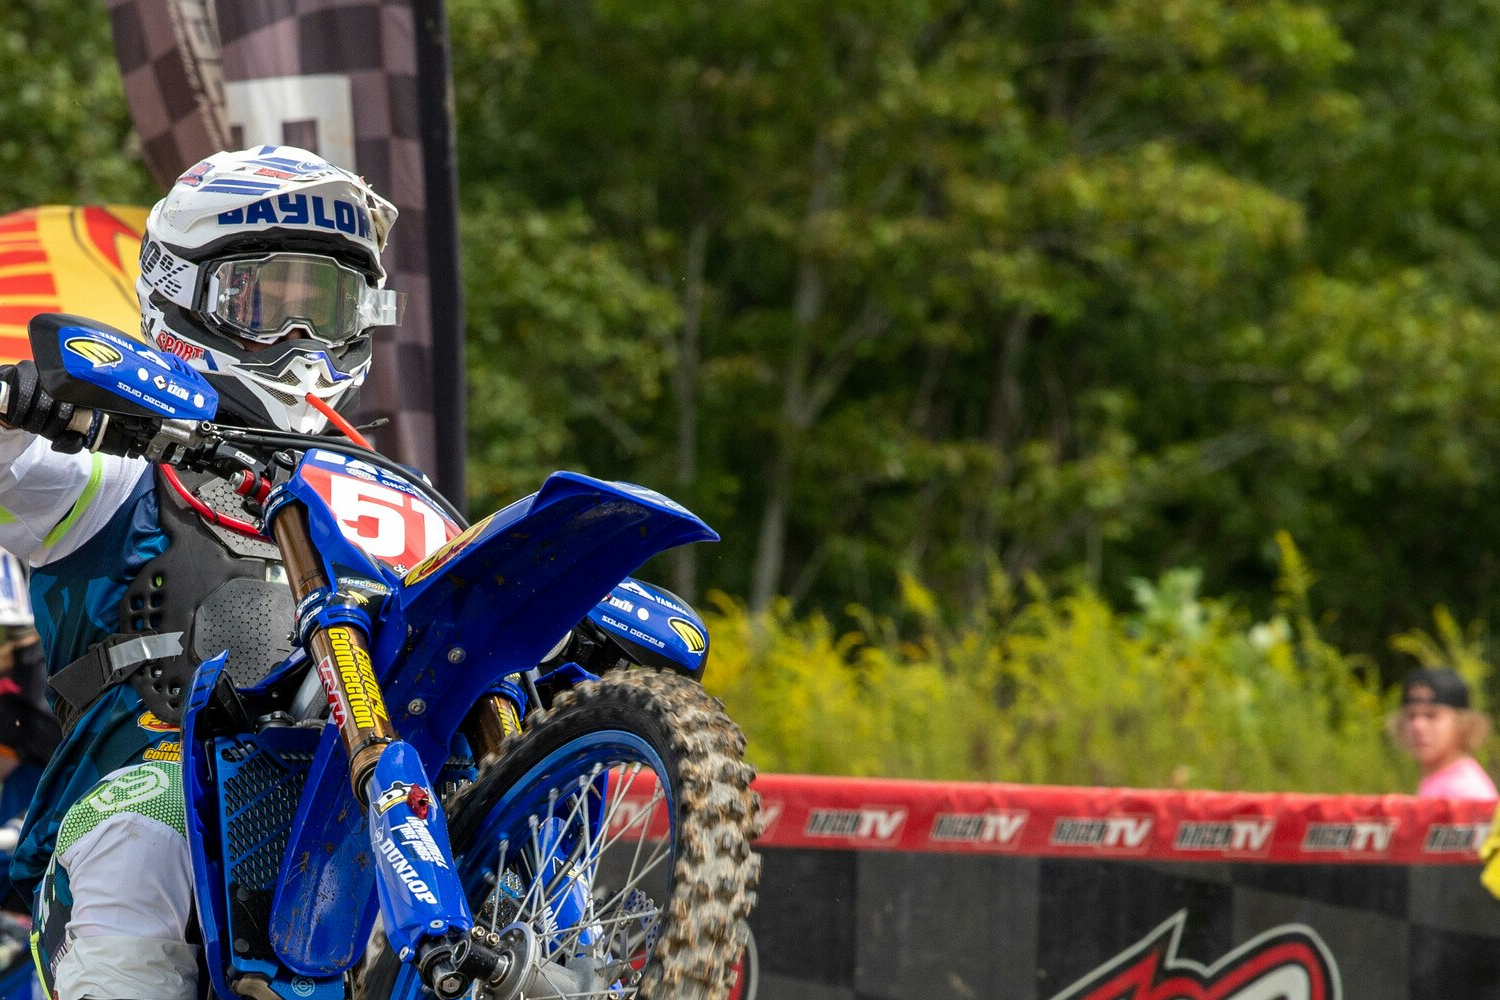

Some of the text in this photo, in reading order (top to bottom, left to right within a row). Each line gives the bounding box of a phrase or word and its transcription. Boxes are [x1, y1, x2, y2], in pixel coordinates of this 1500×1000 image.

[330, 474, 448, 558] 51
[327, 627, 375, 729] Connection
[380, 838, 437, 904] DUNLOP
